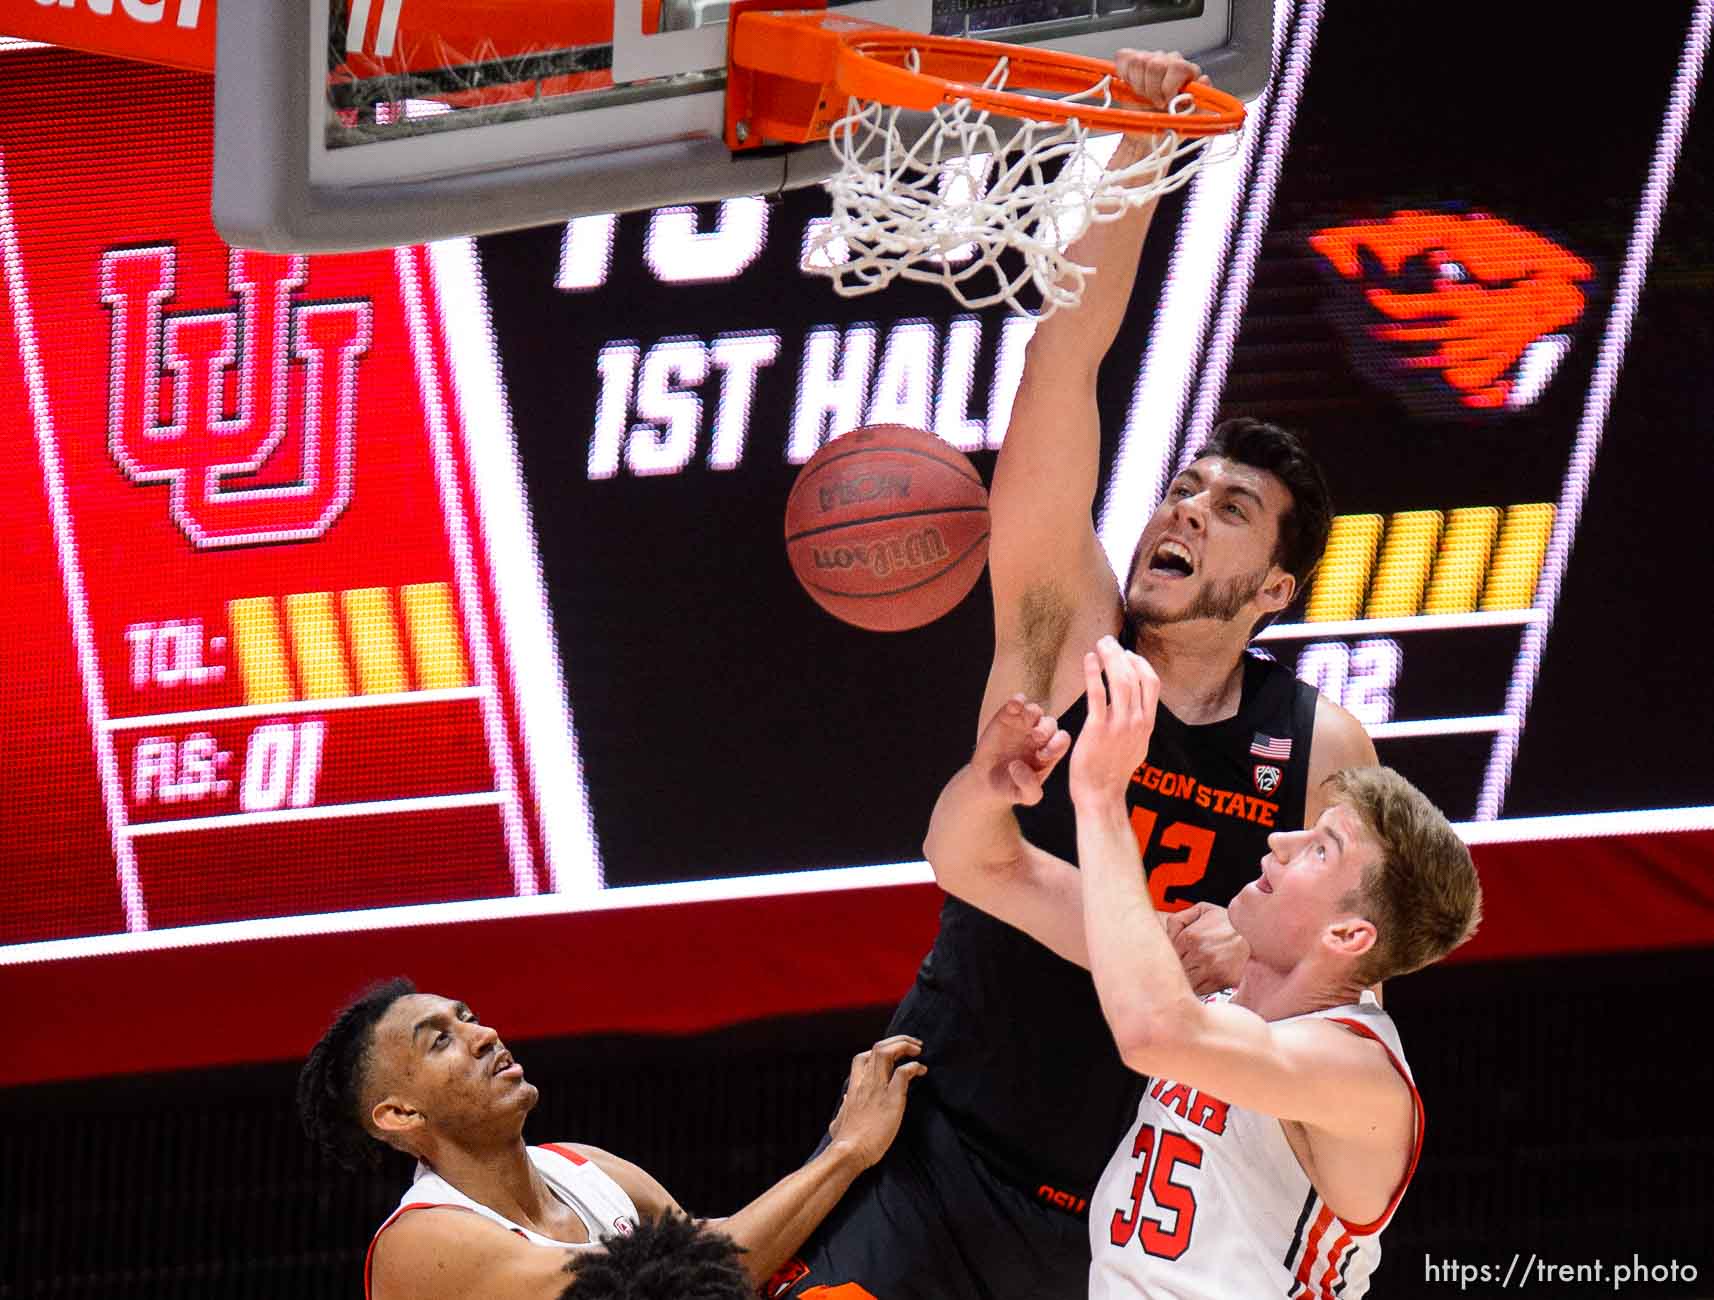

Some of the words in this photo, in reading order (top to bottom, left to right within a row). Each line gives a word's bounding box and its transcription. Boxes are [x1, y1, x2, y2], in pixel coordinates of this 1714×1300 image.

[587, 331, 781, 480] 1ST
[812, 525, 950, 577] Wilson
[240, 717, 328, 811] 01
[1129, 761, 1196, 800] EGON
[1195, 783, 1280, 828] STATE
[1110, 1122, 1204, 1261] 35
